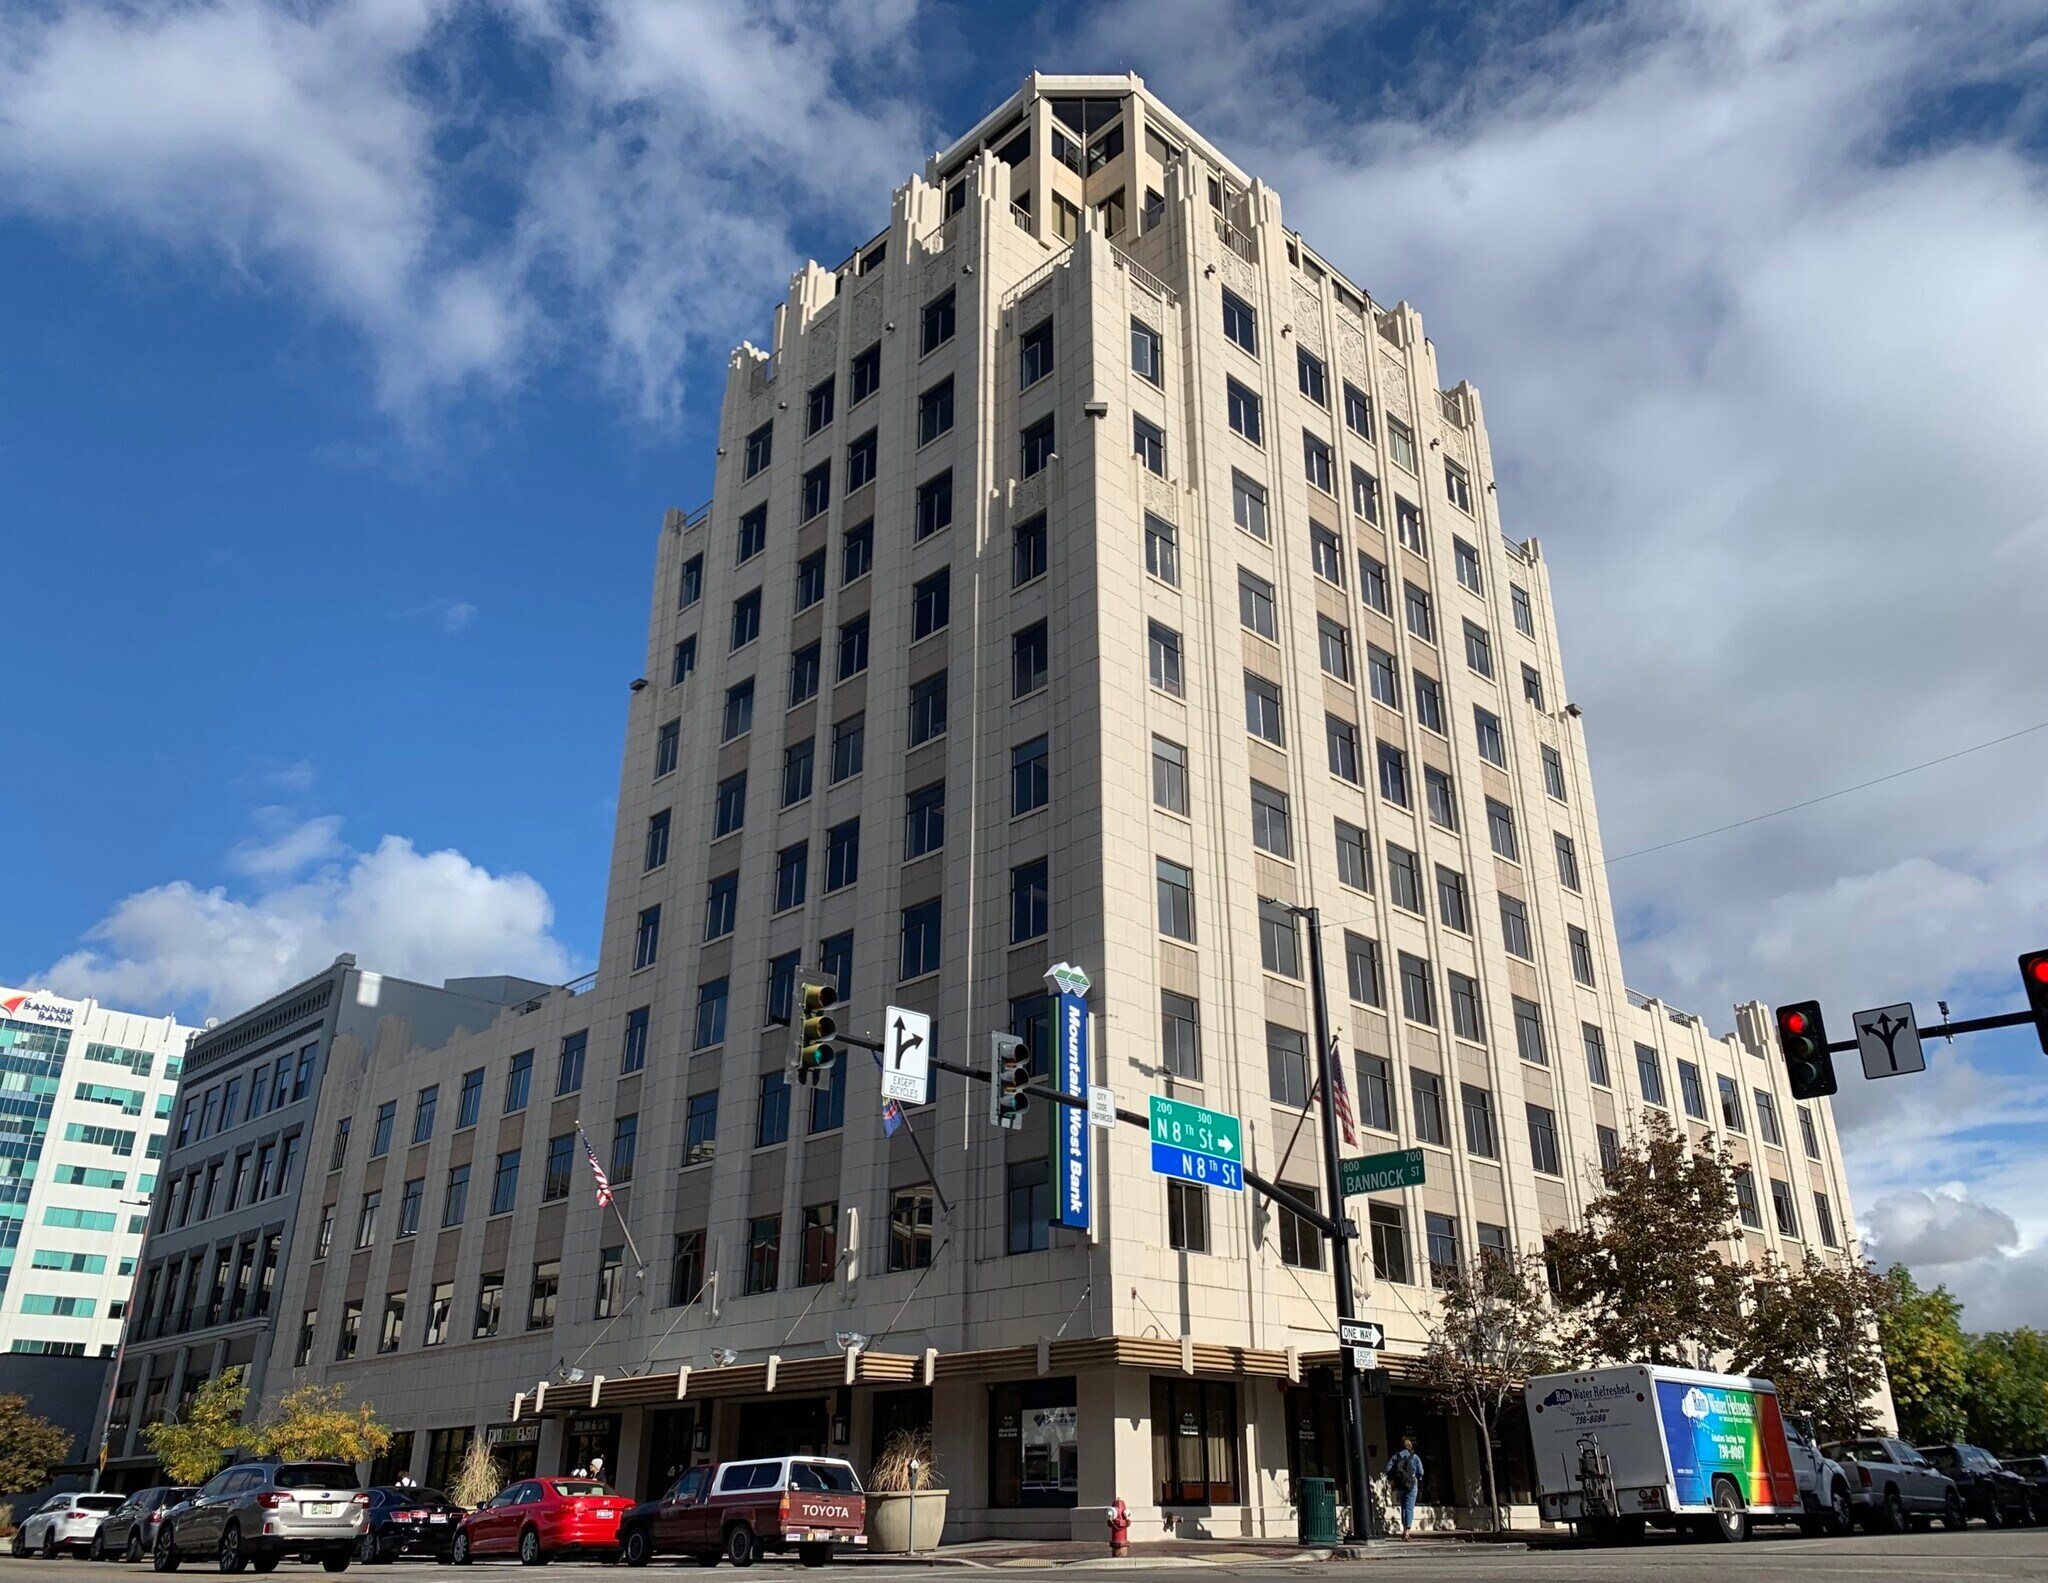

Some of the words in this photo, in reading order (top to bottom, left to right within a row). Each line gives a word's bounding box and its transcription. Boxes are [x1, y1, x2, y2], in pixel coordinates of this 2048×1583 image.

[23, 1001, 74, 1016] BANNER
[37, 1011, 72, 1025] BANK
[893, 1075, 916, 1087] EXCEPT
[889, 1085, 918, 1099] BICYCLES
[1156, 1101, 1172, 1115] 200
[1197, 1111, 1212, 1125] 300
[1069, 1108, 1081, 1157] West
[1157, 1117, 1168, 1140] N
[1199, 1128, 1213, 1151] St
[1182, 1153, 1193, 1176] N
[1222, 1163, 1236, 1186] St
[1343, 1161, 1360, 1173] 800
[1404, 1150, 1421, 1162] 700
[1070, 1159, 1082, 1214] Bank
[1346, 1168, 1405, 1193] BANNOCK
[1410, 1166, 1420, 1177] ST
[1343, 1327, 1357, 1339] ONE
[1359, 1329, 1372, 1341] WAY
[1572, 1388, 1593, 1400] Water
[1593, 1382, 1631, 1398] Refreshed
[802, 1504, 849, 1518] TOYOTA
